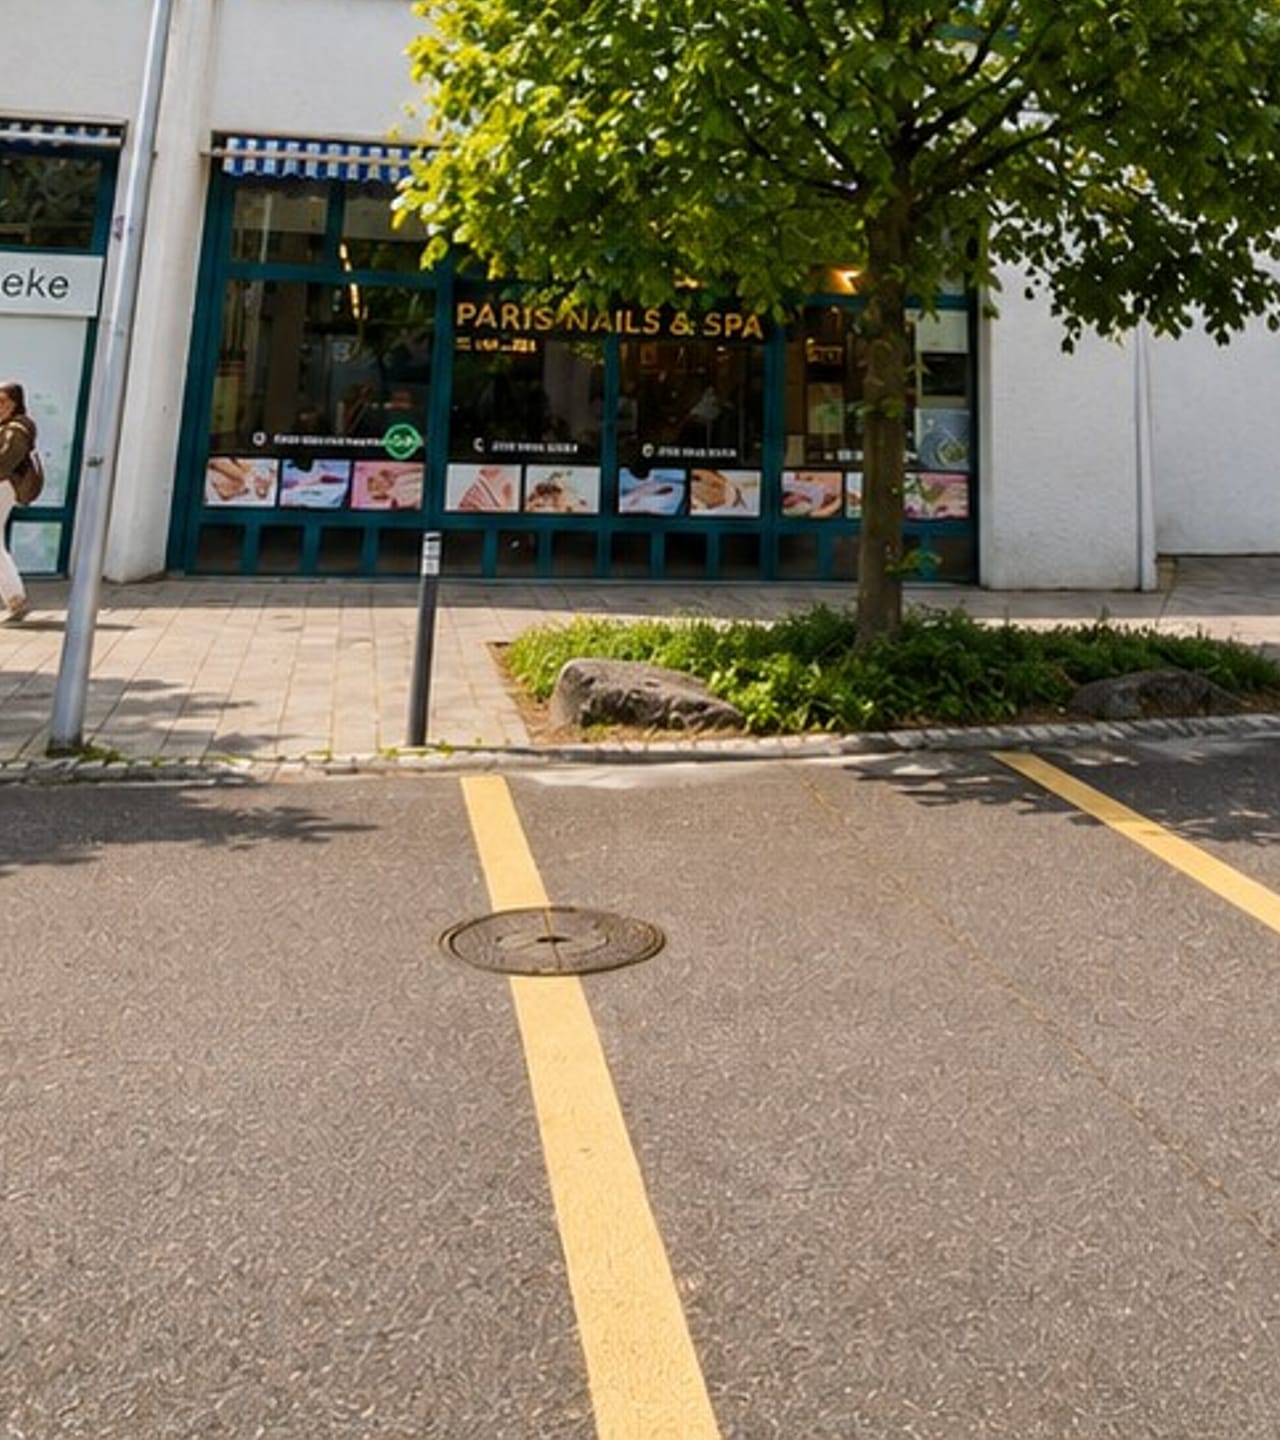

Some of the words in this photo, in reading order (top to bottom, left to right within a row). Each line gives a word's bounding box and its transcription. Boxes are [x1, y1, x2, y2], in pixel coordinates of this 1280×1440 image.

[455, 301, 554, 332] PARIS
[565, 307, 661, 336] NAILS
[669, 311, 696, 337] &
[703, 313, 764, 340] SPA
